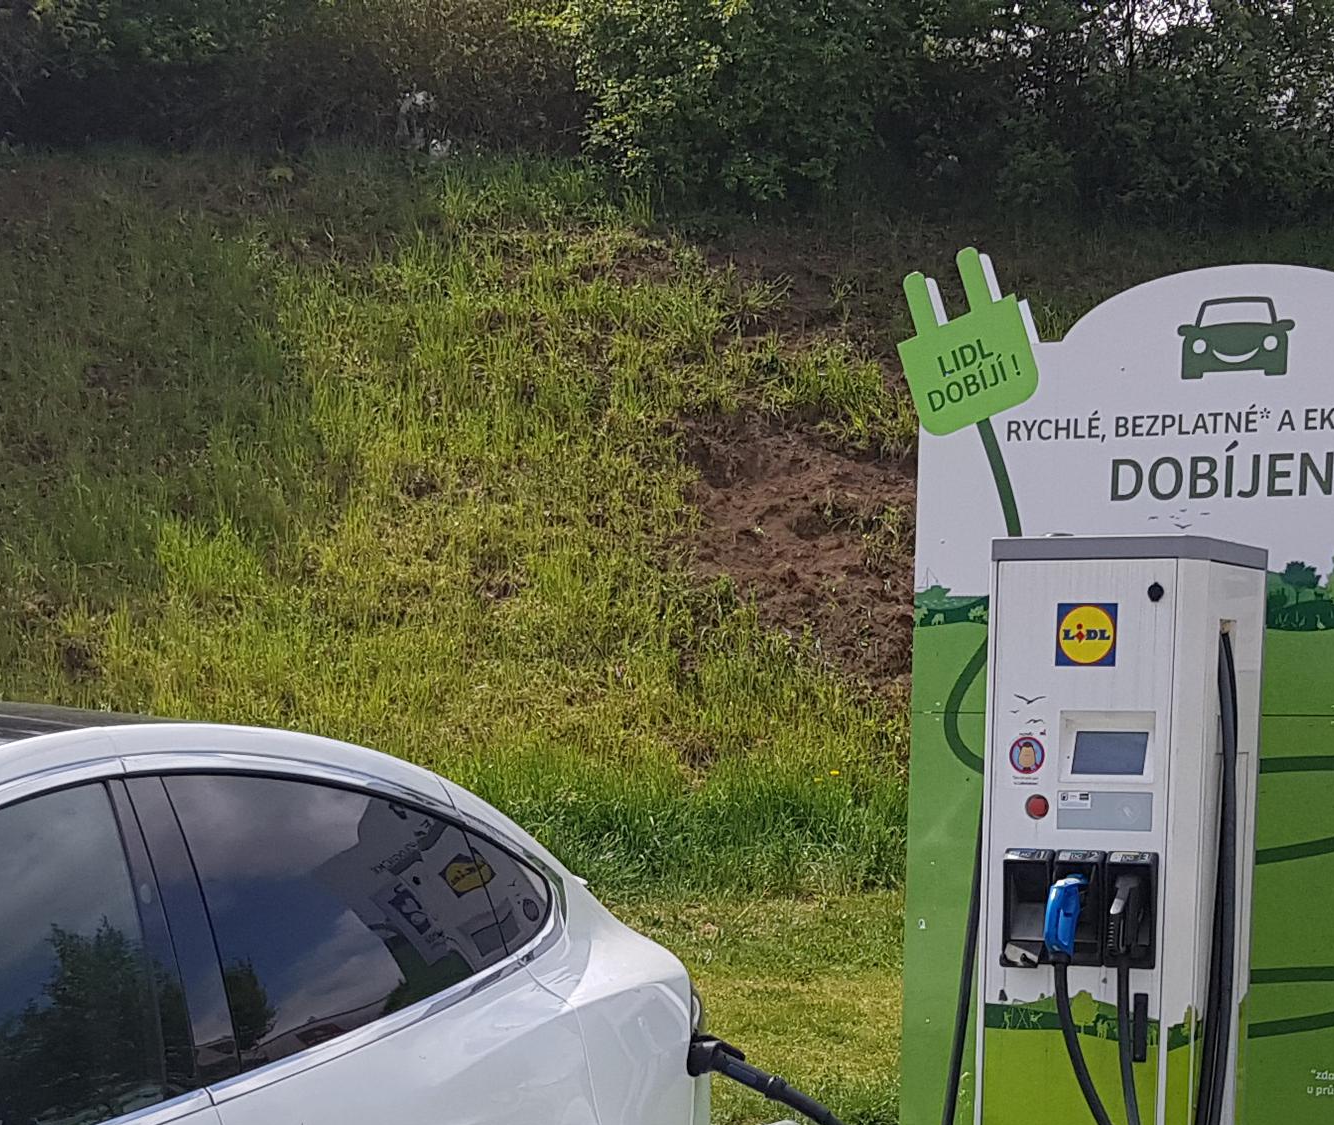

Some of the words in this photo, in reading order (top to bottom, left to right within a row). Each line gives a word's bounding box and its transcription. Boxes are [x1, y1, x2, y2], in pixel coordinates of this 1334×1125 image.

[937, 338, 994, 377] LIDL
[927, 353, 1007, 412] DOBÍJÍ
[1006, 410, 1106, 443] RYCHLÉ,
[1277, 409, 1296, 432] A
[1088, 851, 1099, 860] 2
[1140, 853, 1149, 862] 3
